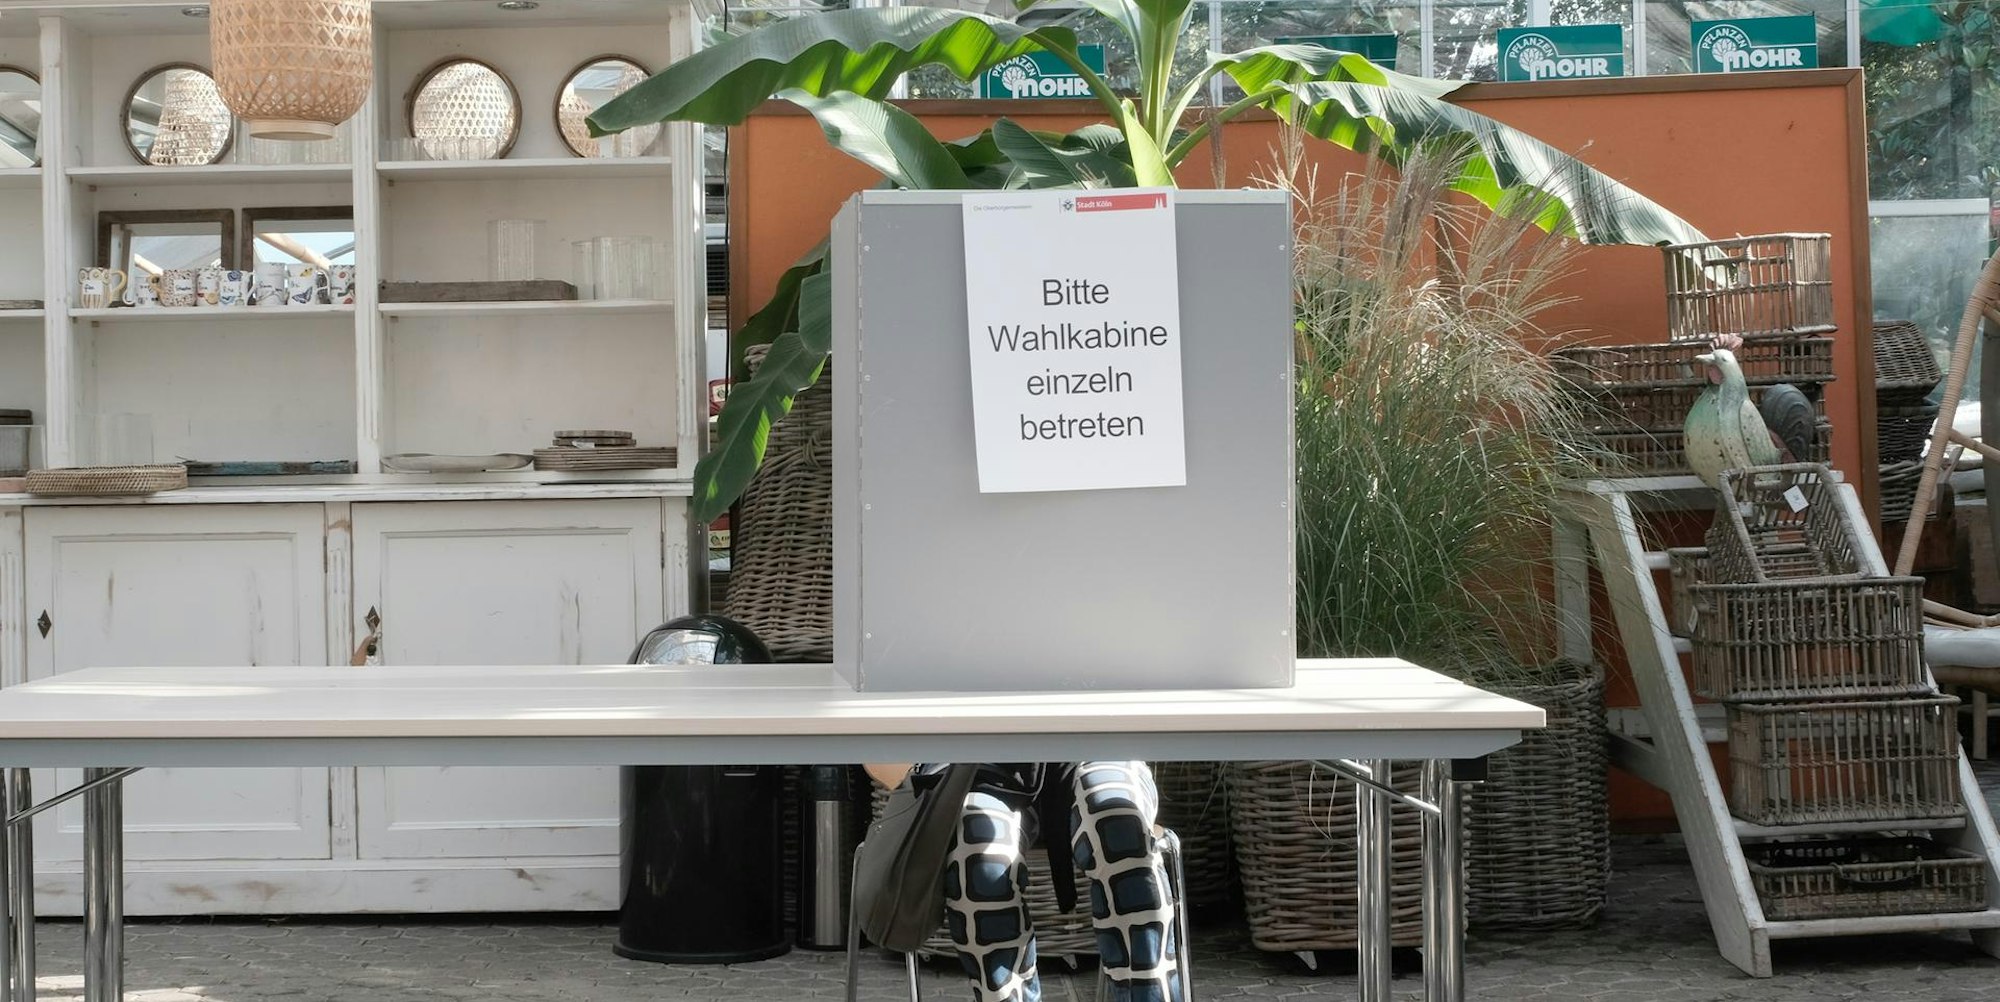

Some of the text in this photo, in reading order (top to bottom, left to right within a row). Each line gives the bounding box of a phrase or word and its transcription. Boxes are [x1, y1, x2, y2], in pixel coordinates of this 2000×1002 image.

[1508, 37, 1554, 58] PFLANZEN
[1701, 28, 1747, 50] PFLANZEN
[991, 55, 1037, 77] PFLANZEN
[1077, 199, 1112, 209] Stadt Köln
[1042, 278, 1109, 306] Bitte
[987, 320, 1168, 352] Wahlkabine
[1026, 365, 1132, 396] einzeln
[1020, 412, 1144, 440] betreten
